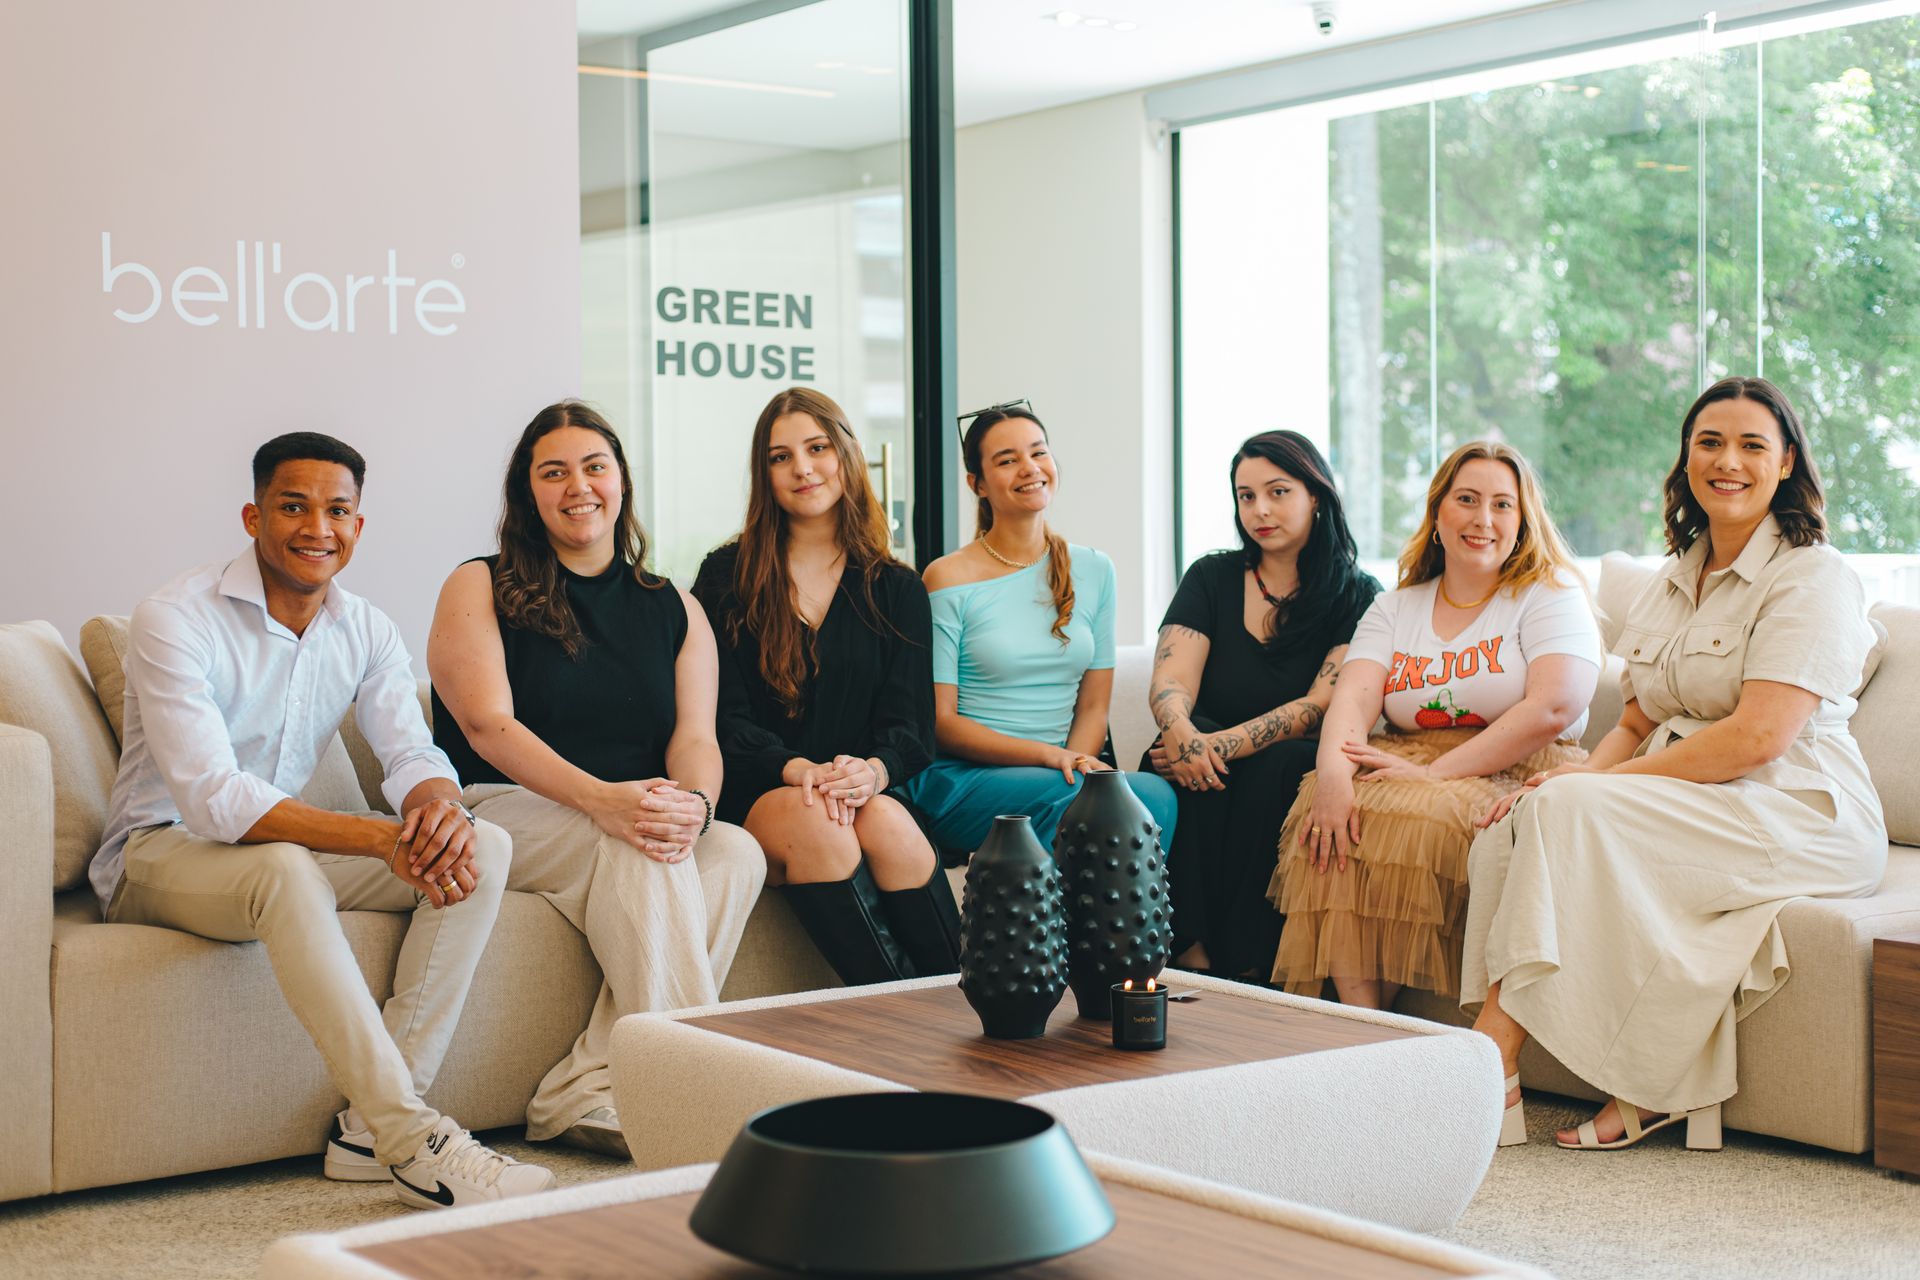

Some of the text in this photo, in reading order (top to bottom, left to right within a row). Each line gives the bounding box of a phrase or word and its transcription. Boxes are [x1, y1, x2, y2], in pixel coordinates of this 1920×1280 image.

[656, 286, 813, 330] GREEN
[656, 340, 815, 382] HOUSE
[1384, 635, 1504, 695] ENJOY
